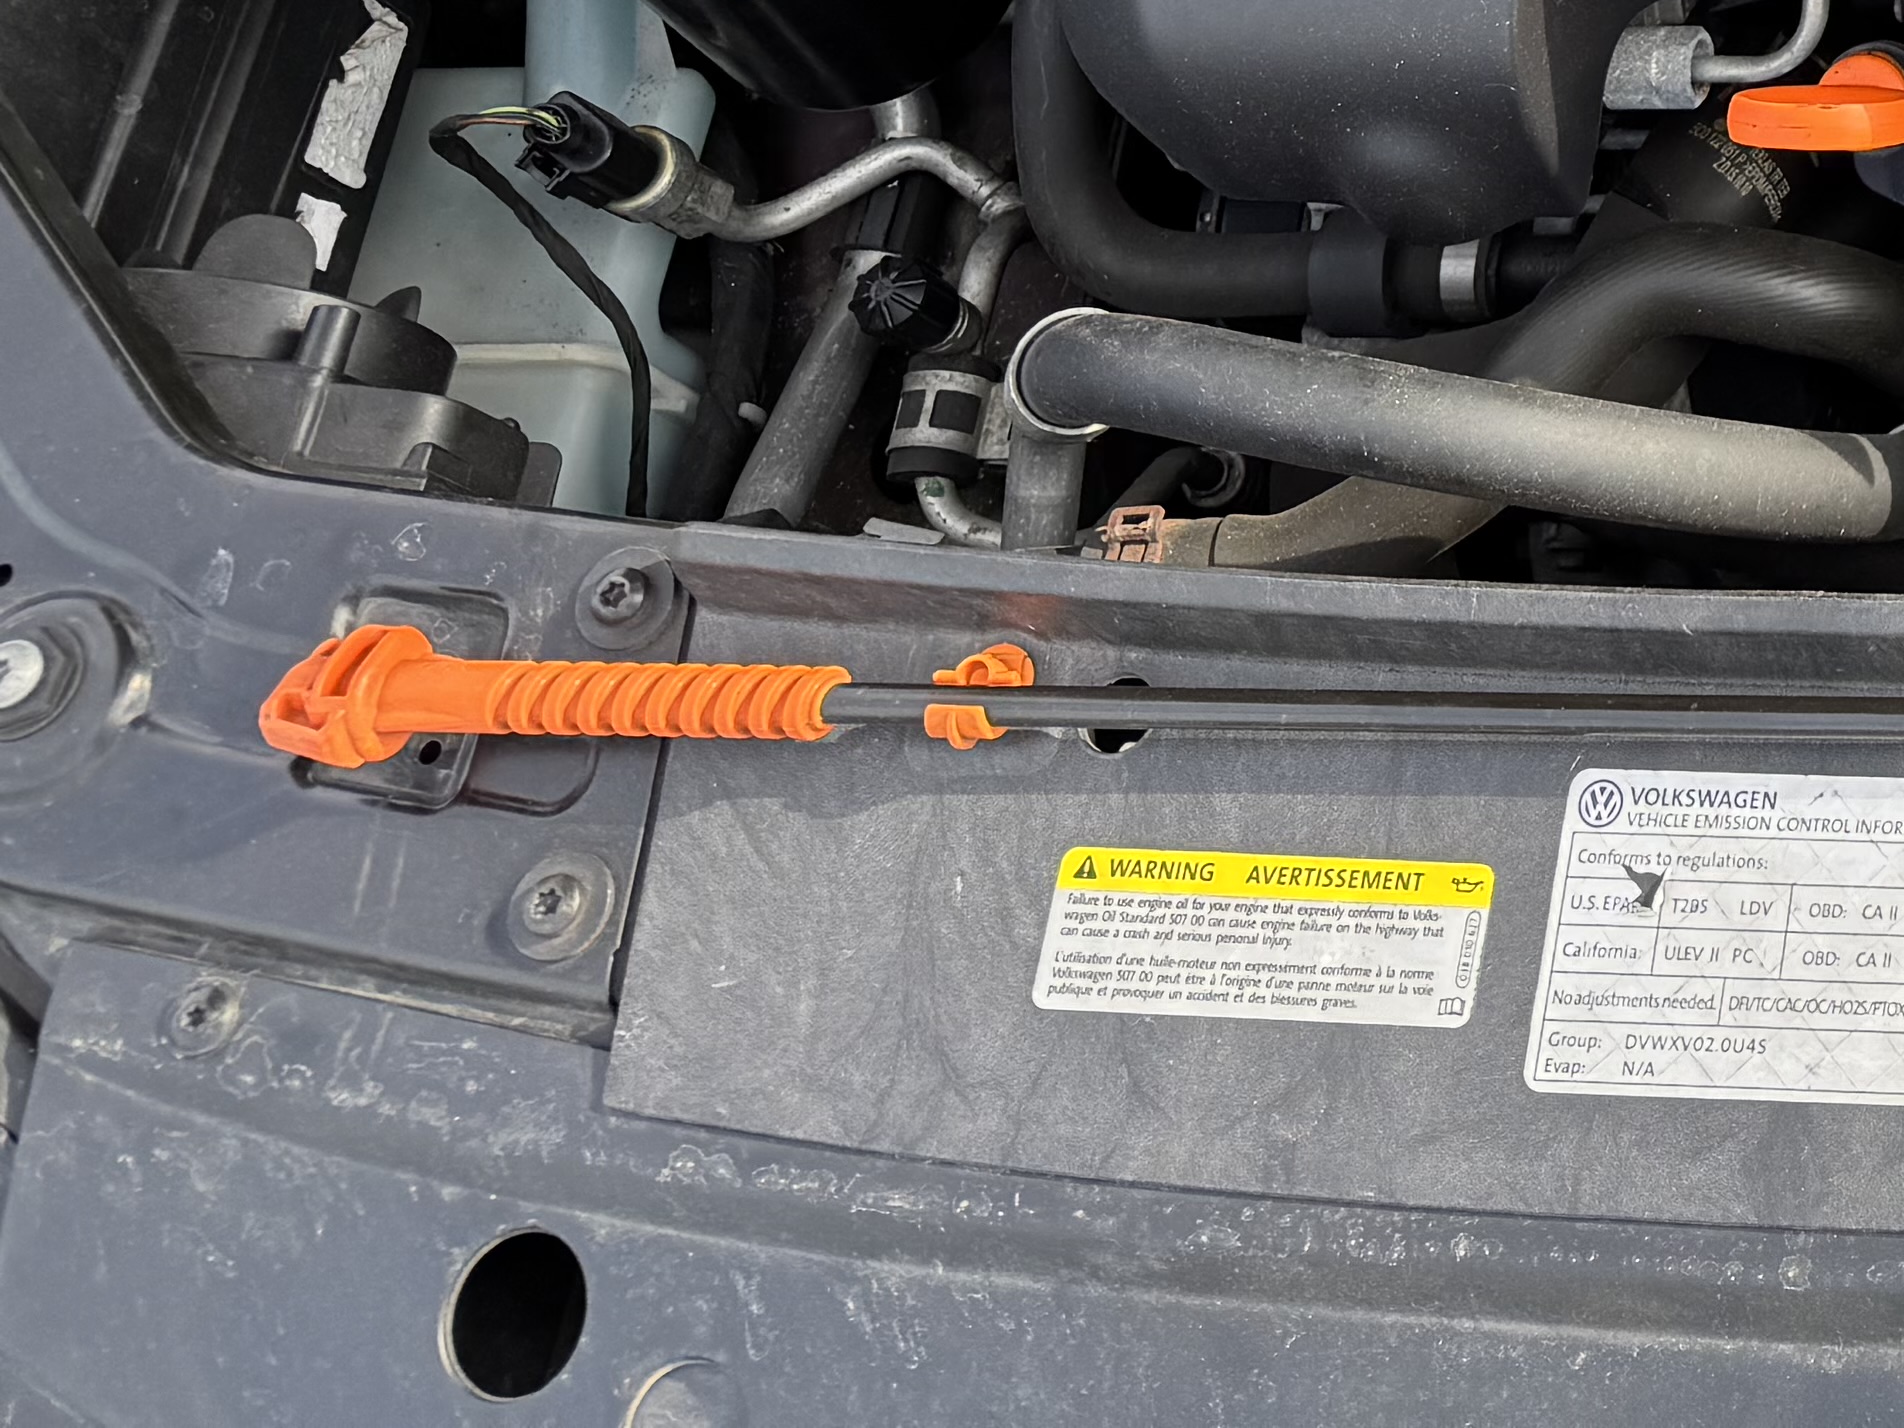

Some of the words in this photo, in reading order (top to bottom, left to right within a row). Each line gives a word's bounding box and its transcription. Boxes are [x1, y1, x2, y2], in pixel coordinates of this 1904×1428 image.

[1628, 786, 1777, 810] VOLKSWAGEN
[1625, 812, 1690, 828] VEHICLE
[1693, 814, 1771, 830] EMISSION
[1775, 816, 1852, 833] CONTROL
[1577, 848, 1652, 866] Conforms
[1654, 850, 1672, 866] to
[1675, 851, 1769, 874] regulations:
[1106, 858, 1216, 881] WARNING
[1245, 864, 1425, 891] AVERTISSEMENT
[1739, 900, 1774, 916] LDV
[1808, 902, 1848, 919] OBD:
[1860, 904, 1884, 920] CA
[1561, 941, 1642, 959] California:
[1663, 945, 1704, 961] ULEV
[1731, 947, 1754, 963] PC
[1801, 949, 1841, 966] OBD:
[1854, 951, 1878, 967] CA
[1546, 1030, 1602, 1053] Group:
[1543, 1058, 1587, 1078] Evap:
[1621, 1061, 1656, 1076] N/A
